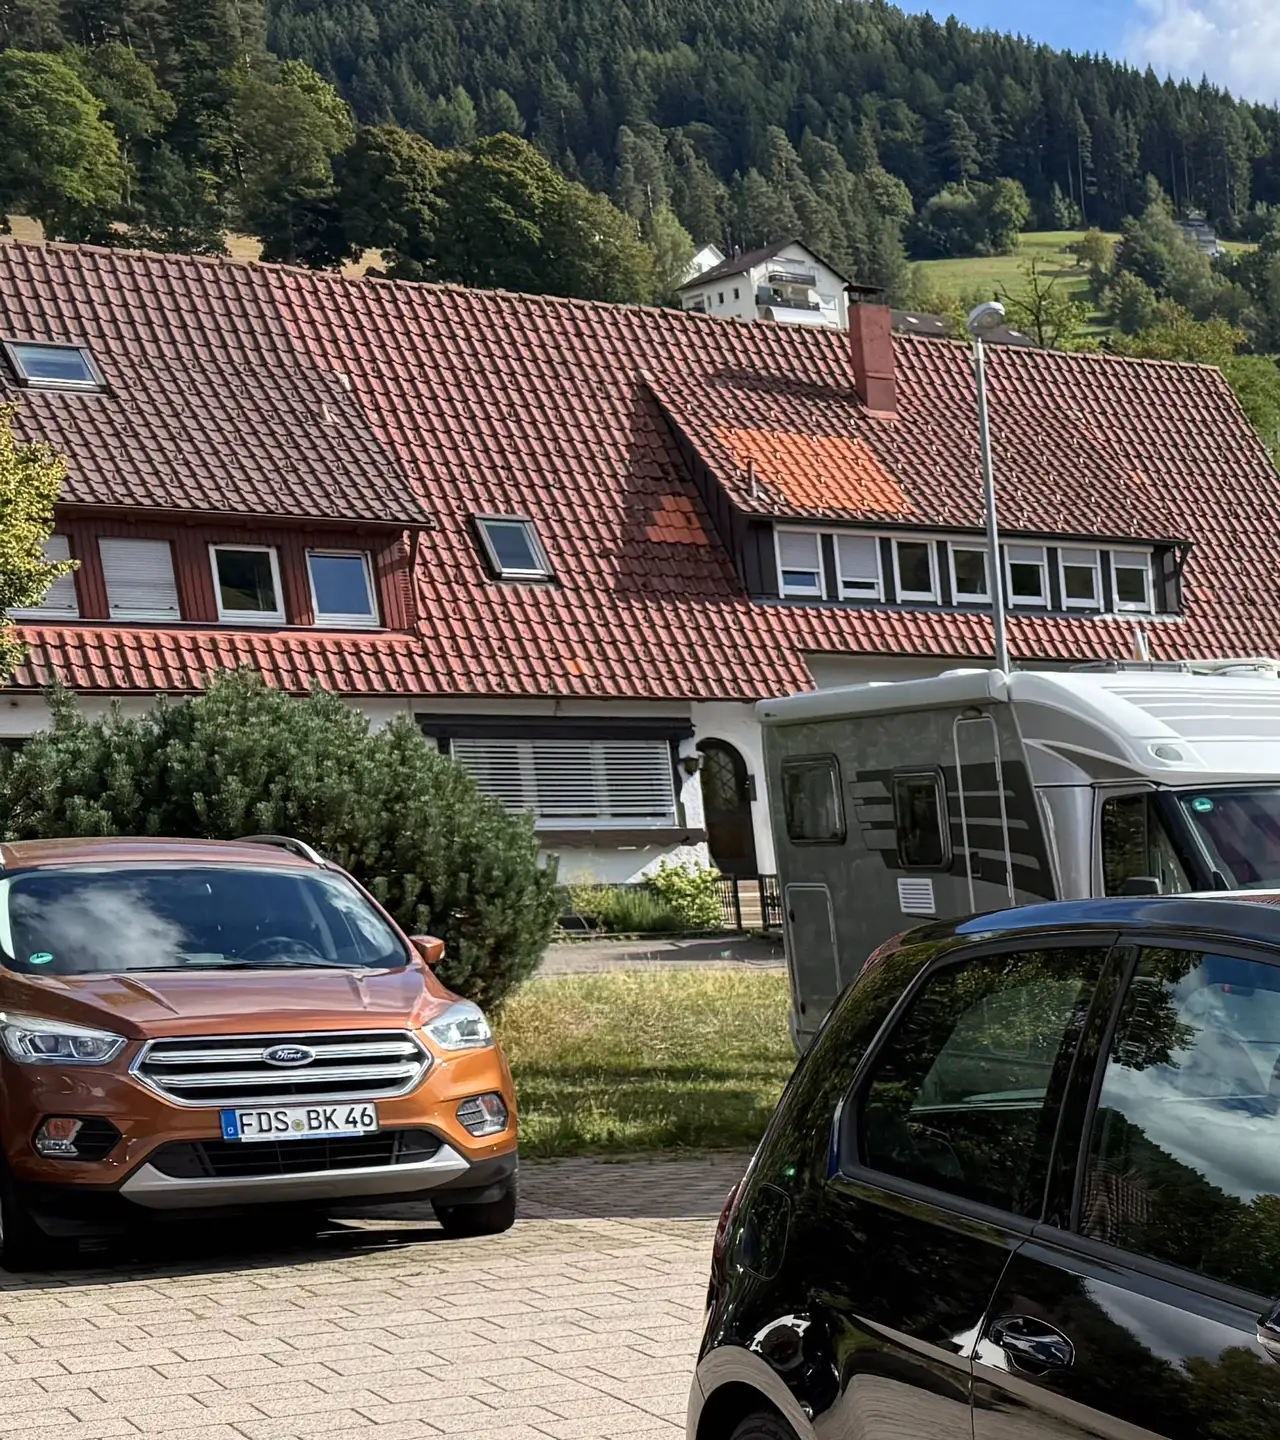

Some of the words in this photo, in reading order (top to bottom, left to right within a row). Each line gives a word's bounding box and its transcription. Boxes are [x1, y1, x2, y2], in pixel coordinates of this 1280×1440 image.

[238, 1111, 290, 1134] FDS
[306, 1109, 339, 1131] BK
[345, 1107, 373, 1129] 46
